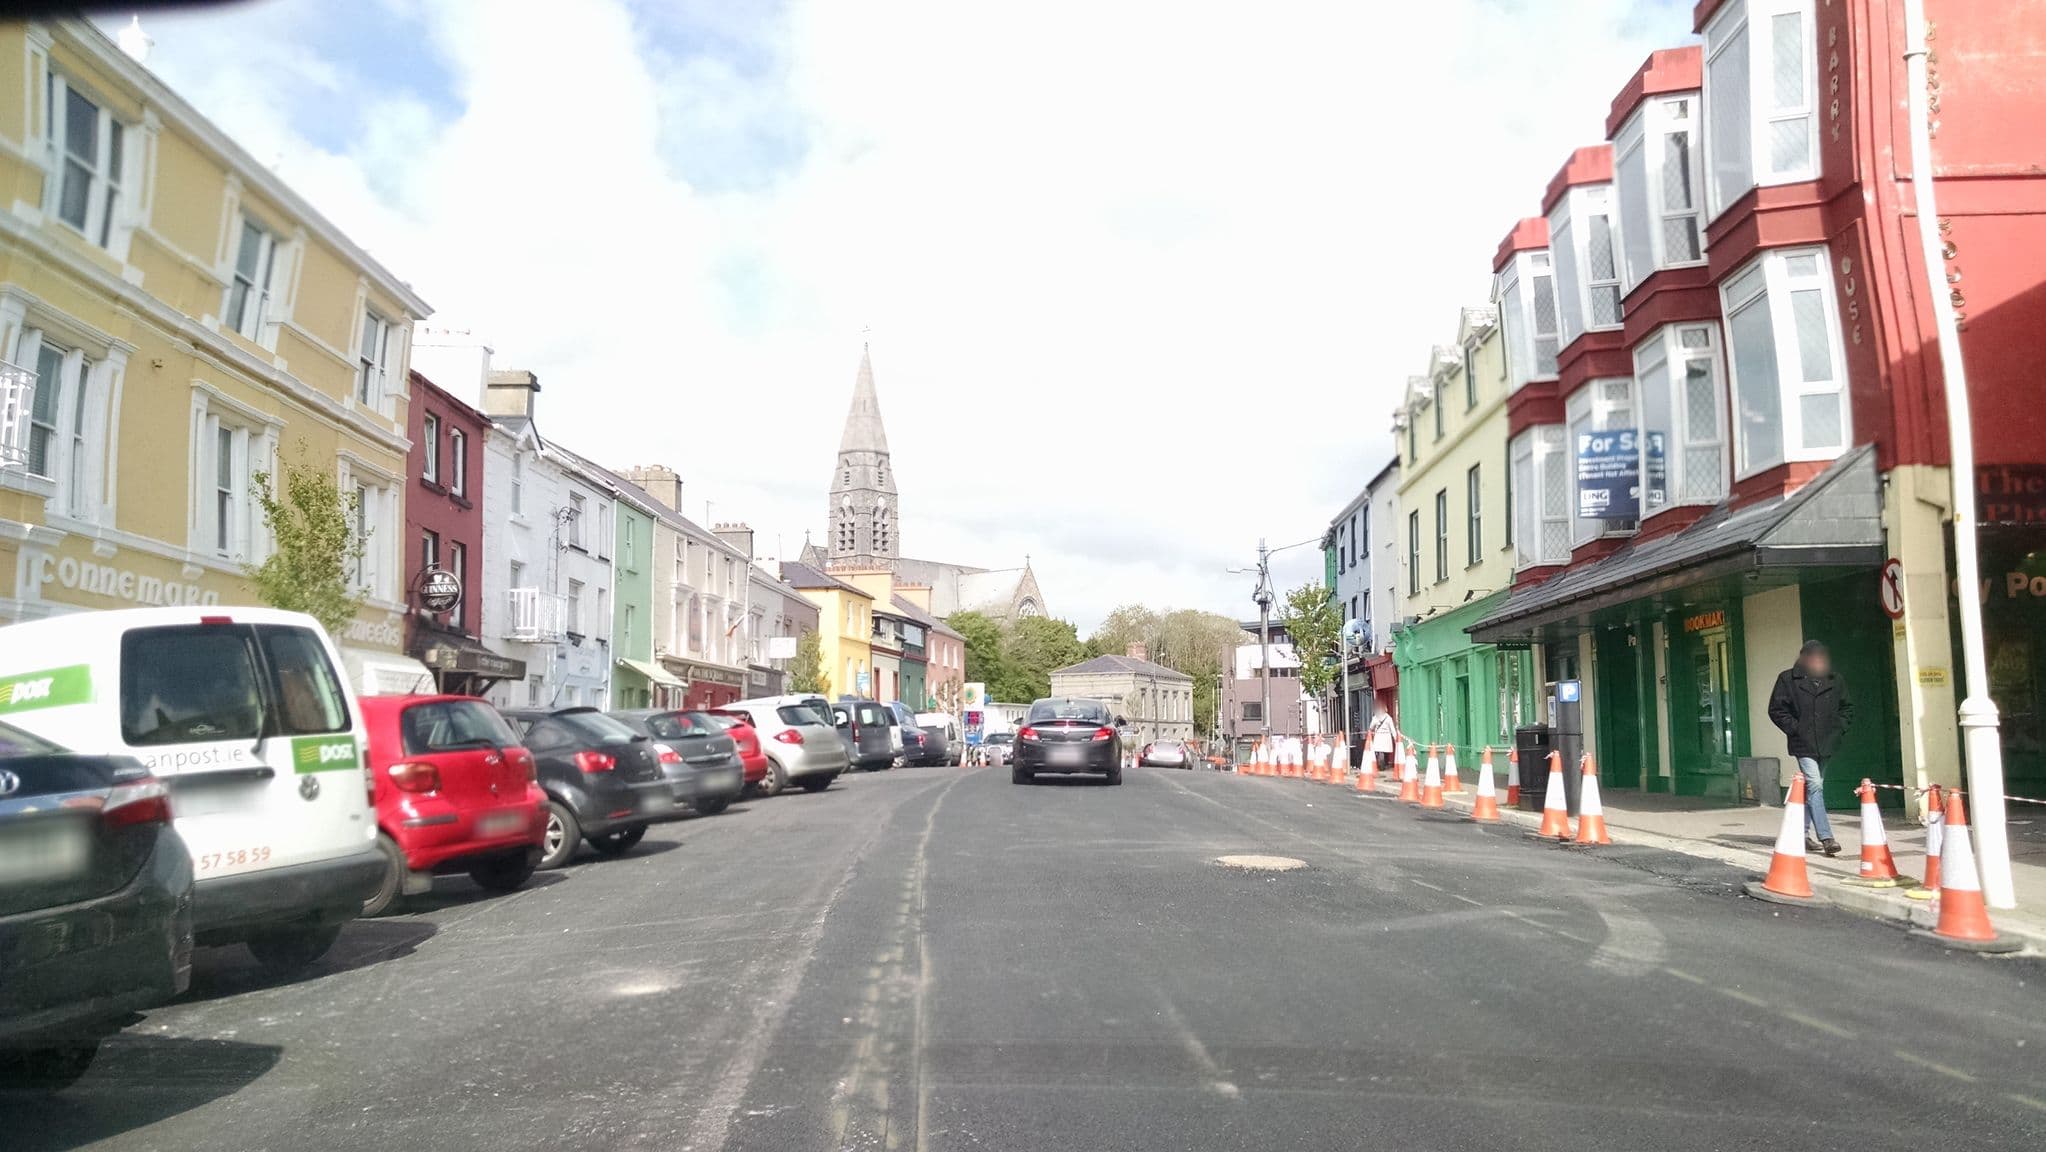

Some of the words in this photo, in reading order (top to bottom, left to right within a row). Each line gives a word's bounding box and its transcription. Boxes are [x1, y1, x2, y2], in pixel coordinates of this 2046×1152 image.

[1828, 26, 1840, 142] BARRY
[1579, 434, 1613, 454] For
[421, 583, 459, 595] GUINNESS
[145, 746, 243, 771] anpost.ie
[200, 853, 221, 871] 57
[227, 849, 248, 866] 58
[251, 846, 271, 863] 59
